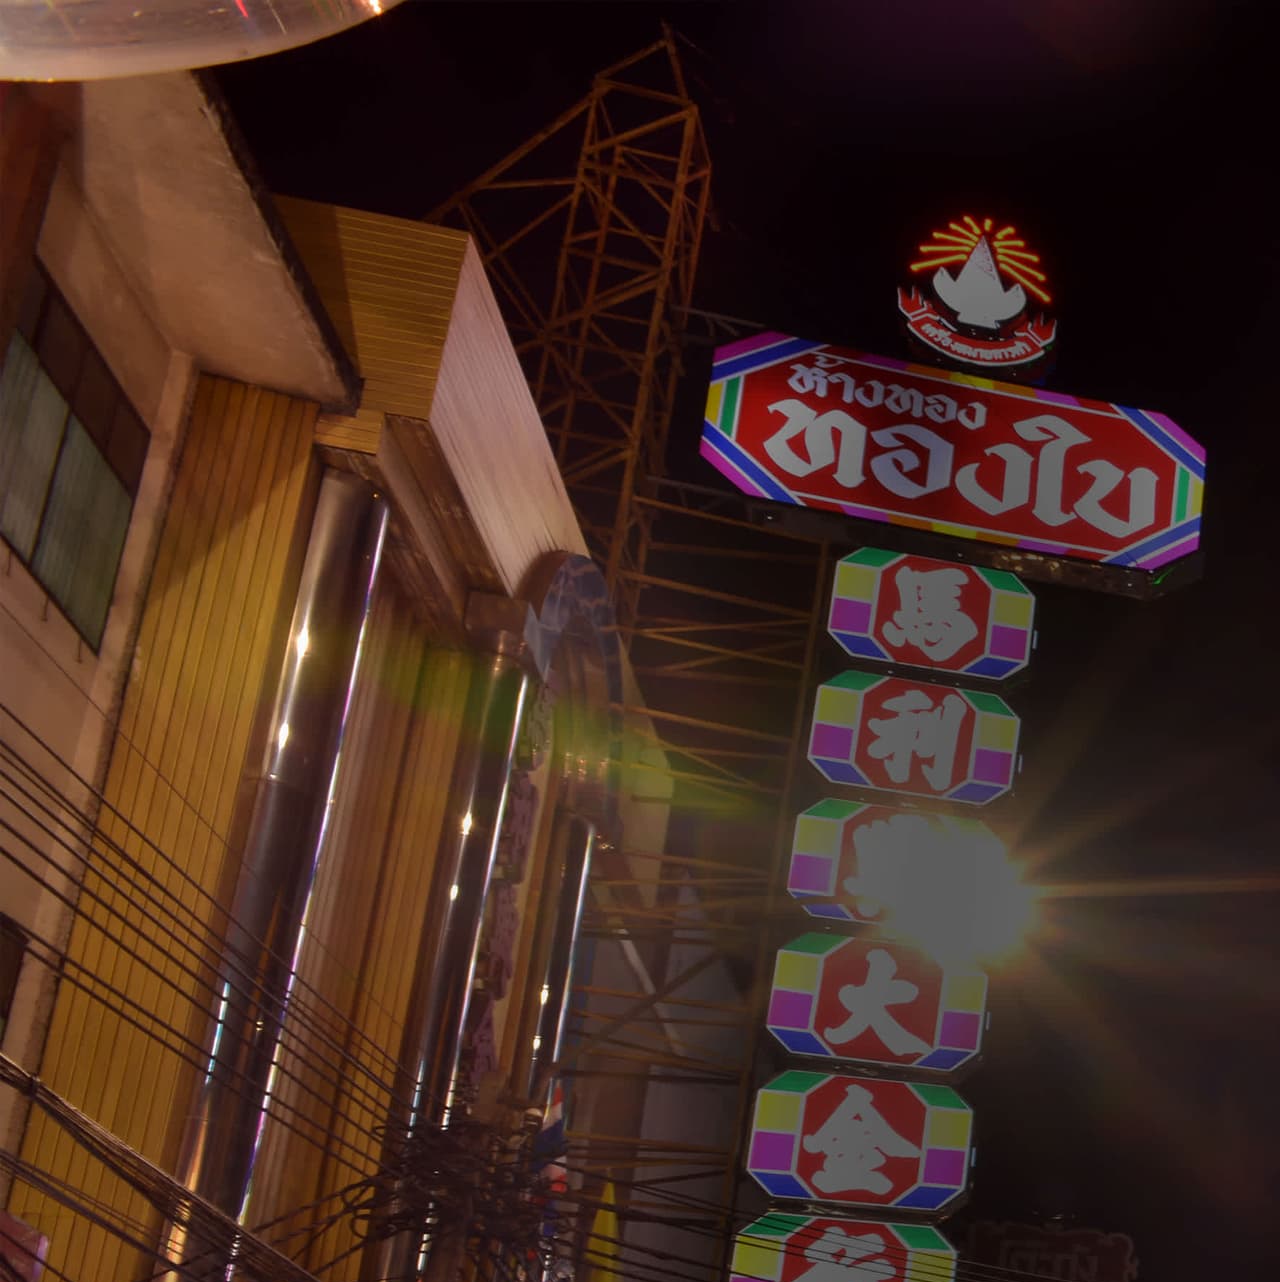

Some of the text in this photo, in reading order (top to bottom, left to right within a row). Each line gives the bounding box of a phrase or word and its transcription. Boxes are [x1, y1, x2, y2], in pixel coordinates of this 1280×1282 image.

[786, 353, 987, 431] ห้างทอง
[763, 398, 1160, 538] ทองใบ
